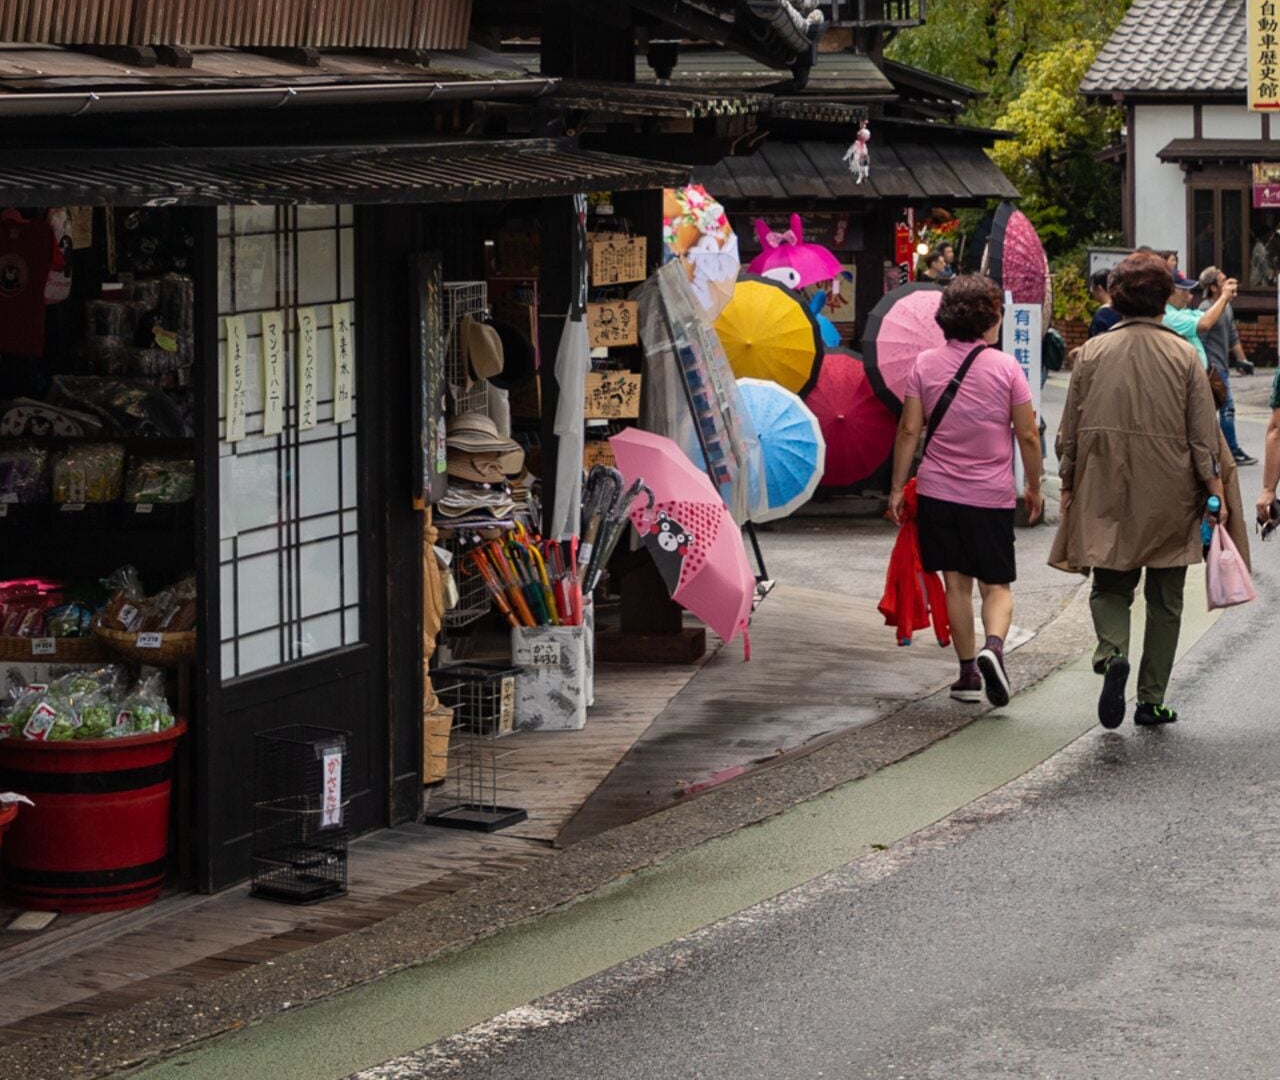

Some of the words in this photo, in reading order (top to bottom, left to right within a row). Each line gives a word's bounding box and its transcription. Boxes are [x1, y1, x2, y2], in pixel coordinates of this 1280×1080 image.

[268, 323, 281, 412] マンゴーハニー
[303, 314, 315, 426] つぶらなカボス
[532, 653, 559, 665] ¥432
[533, 644, 555, 654] かさ
